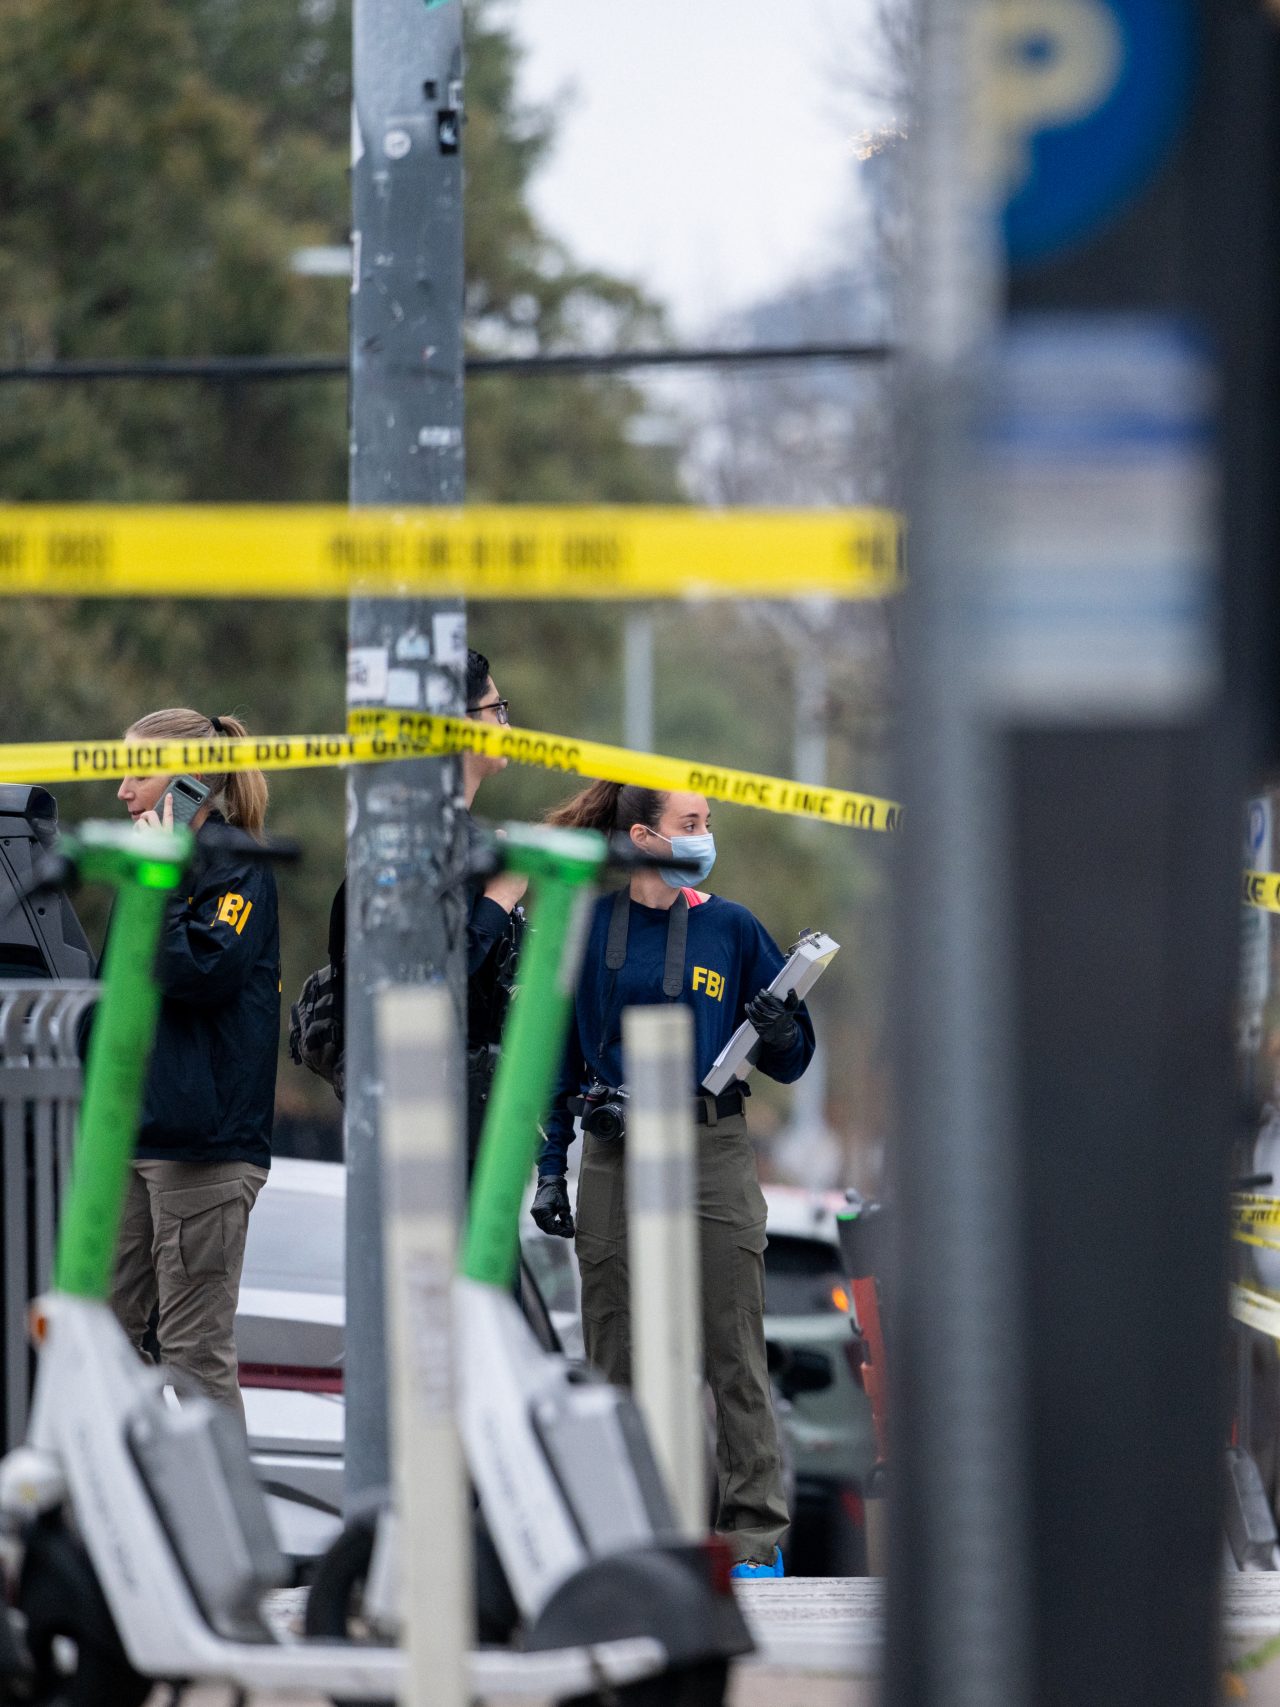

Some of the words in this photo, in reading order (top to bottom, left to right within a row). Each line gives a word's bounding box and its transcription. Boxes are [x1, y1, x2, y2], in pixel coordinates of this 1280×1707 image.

[73, 746, 168, 773] POLICE
[183, 743, 240, 766] LINE
[256, 742, 290, 762] DO
[688, 769, 773, 803] POLICE
[779, 789, 835, 815] LINE
[210, 891, 253, 935] BI
[692, 966, 725, 1002] FBI
